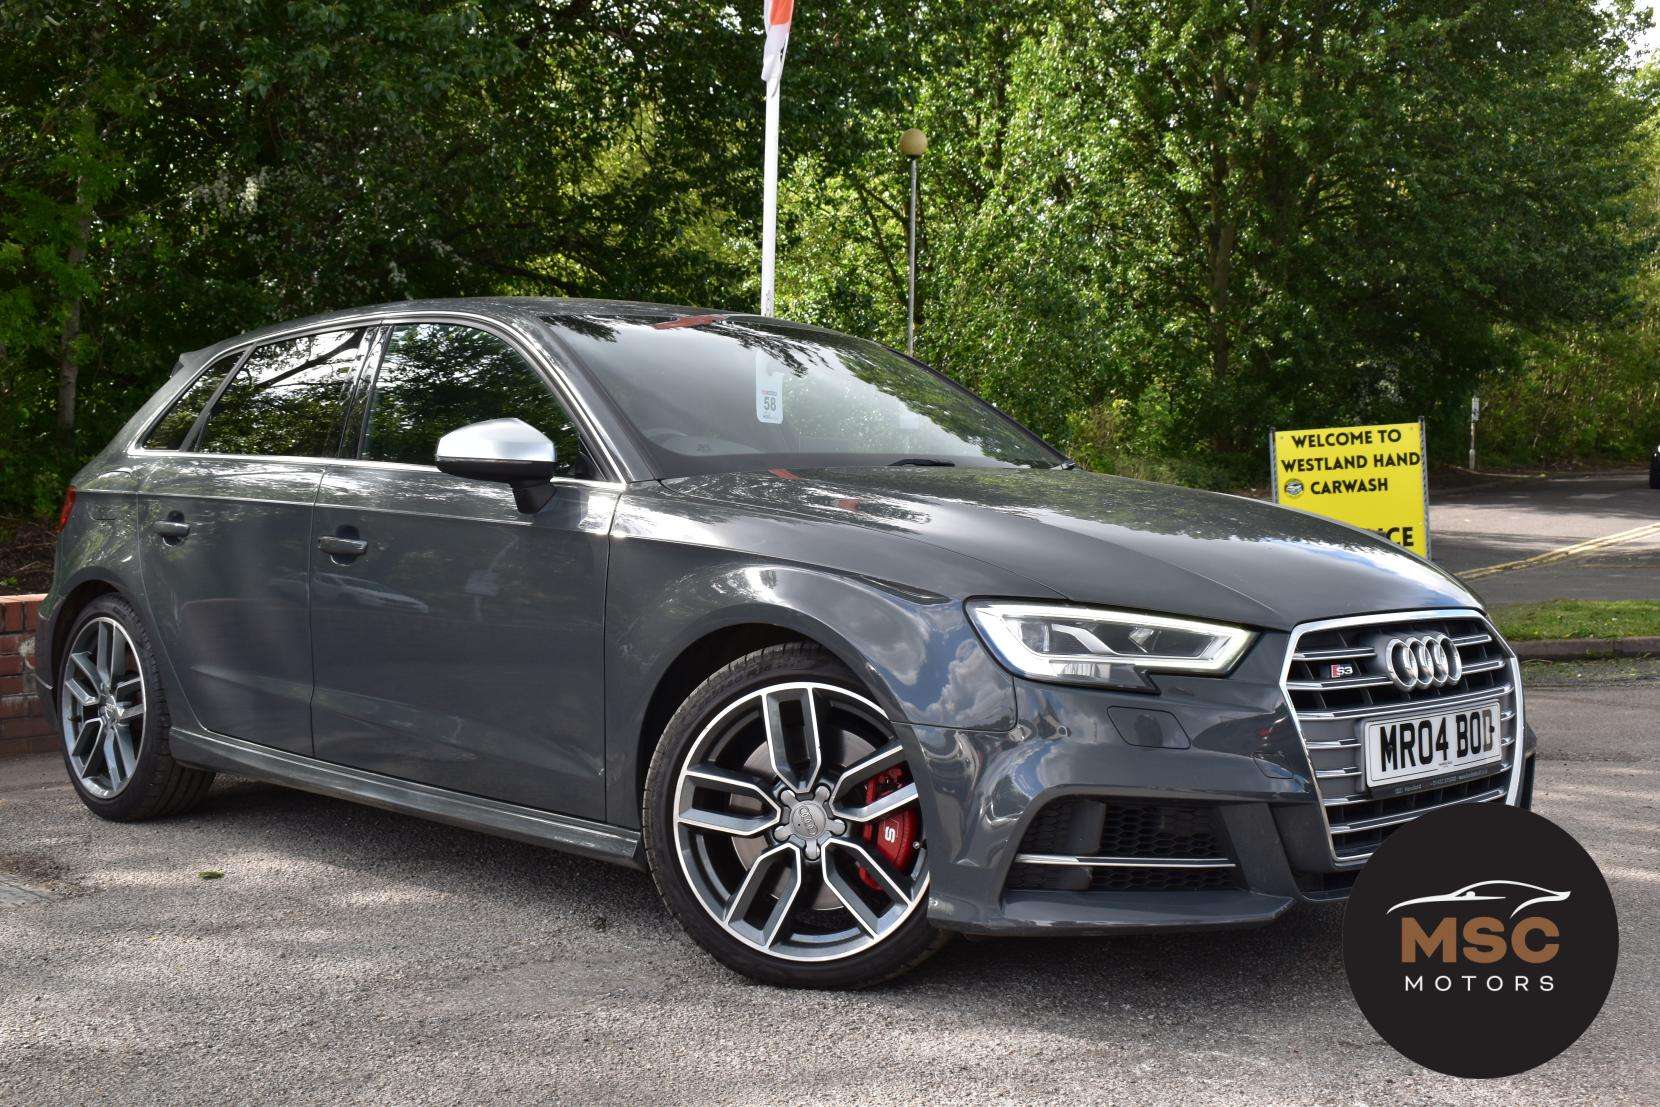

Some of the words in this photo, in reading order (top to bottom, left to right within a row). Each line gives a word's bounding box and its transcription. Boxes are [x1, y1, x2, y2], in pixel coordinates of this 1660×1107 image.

[763, 397, 777, 411] 58
[1291, 430, 1373, 448] WELCOME
[1378, 429, 1402, 443] TO
[1281, 455, 1368, 473] WESTLAND
[1373, 452, 1421, 468] HAND
[1310, 477, 1388, 495] CARWASH
[1335, 666, 1353, 676] S3
[1379, 717, 1449, 773] MR04
[1456, 708, 1493, 759] BOD
